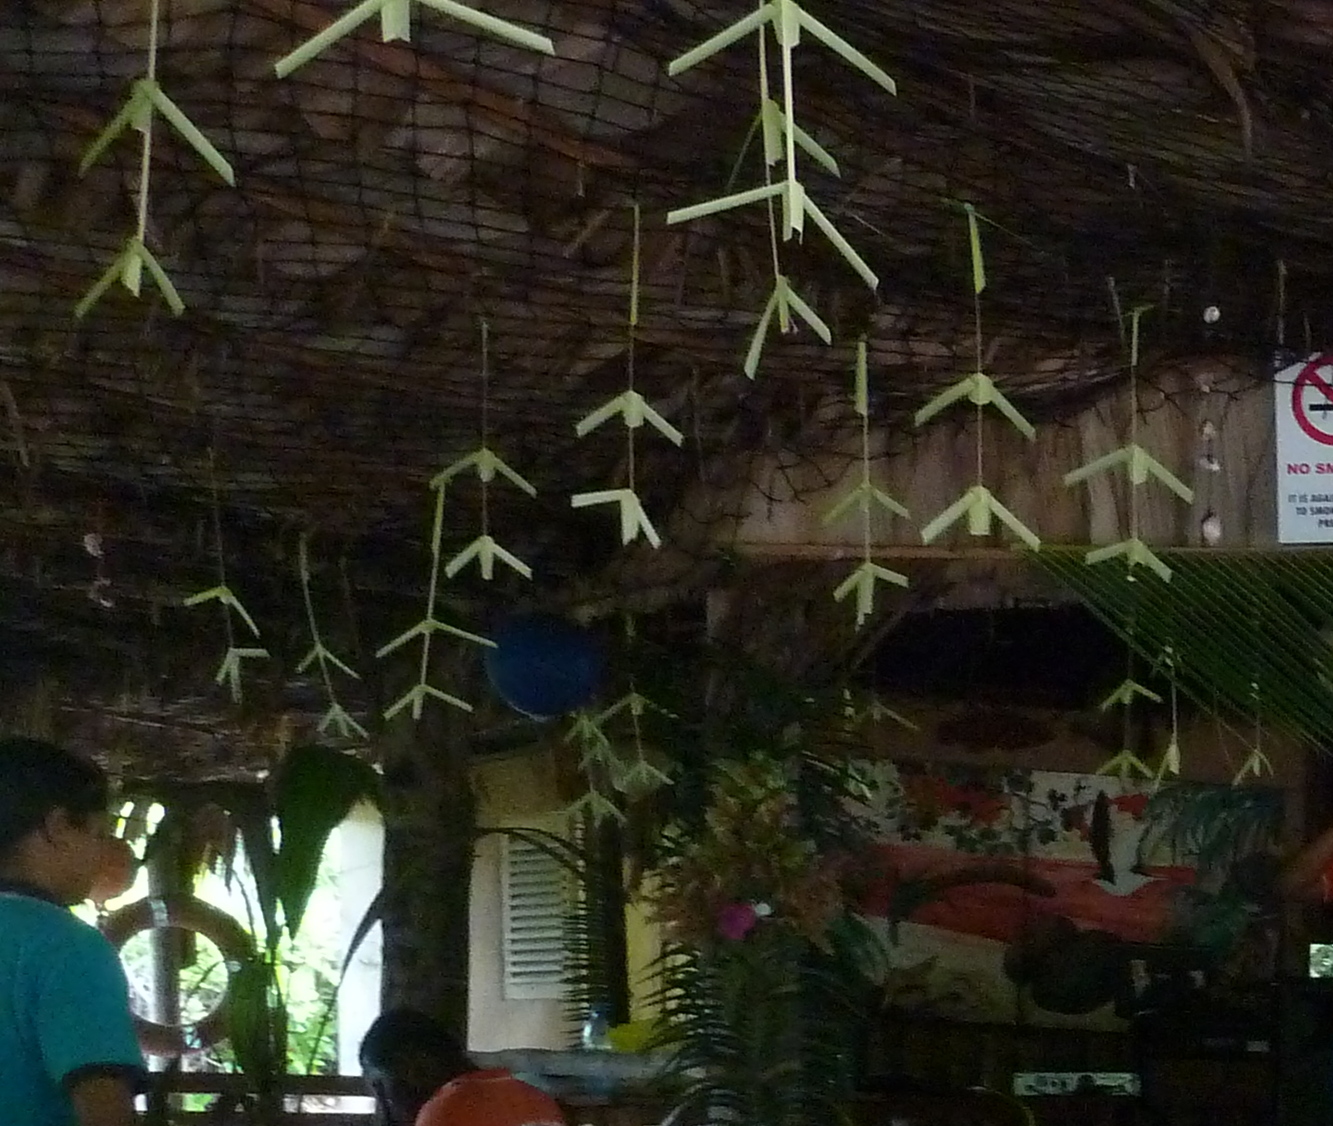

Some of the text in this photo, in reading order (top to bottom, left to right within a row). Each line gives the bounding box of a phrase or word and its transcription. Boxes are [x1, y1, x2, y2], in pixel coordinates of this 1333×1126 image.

[1287, 463, 1311, 475] NO
[1288, 493, 1297, 502] IT
[1299, 493, 1308, 503] IS
[1296, 506, 1307, 515] TO
